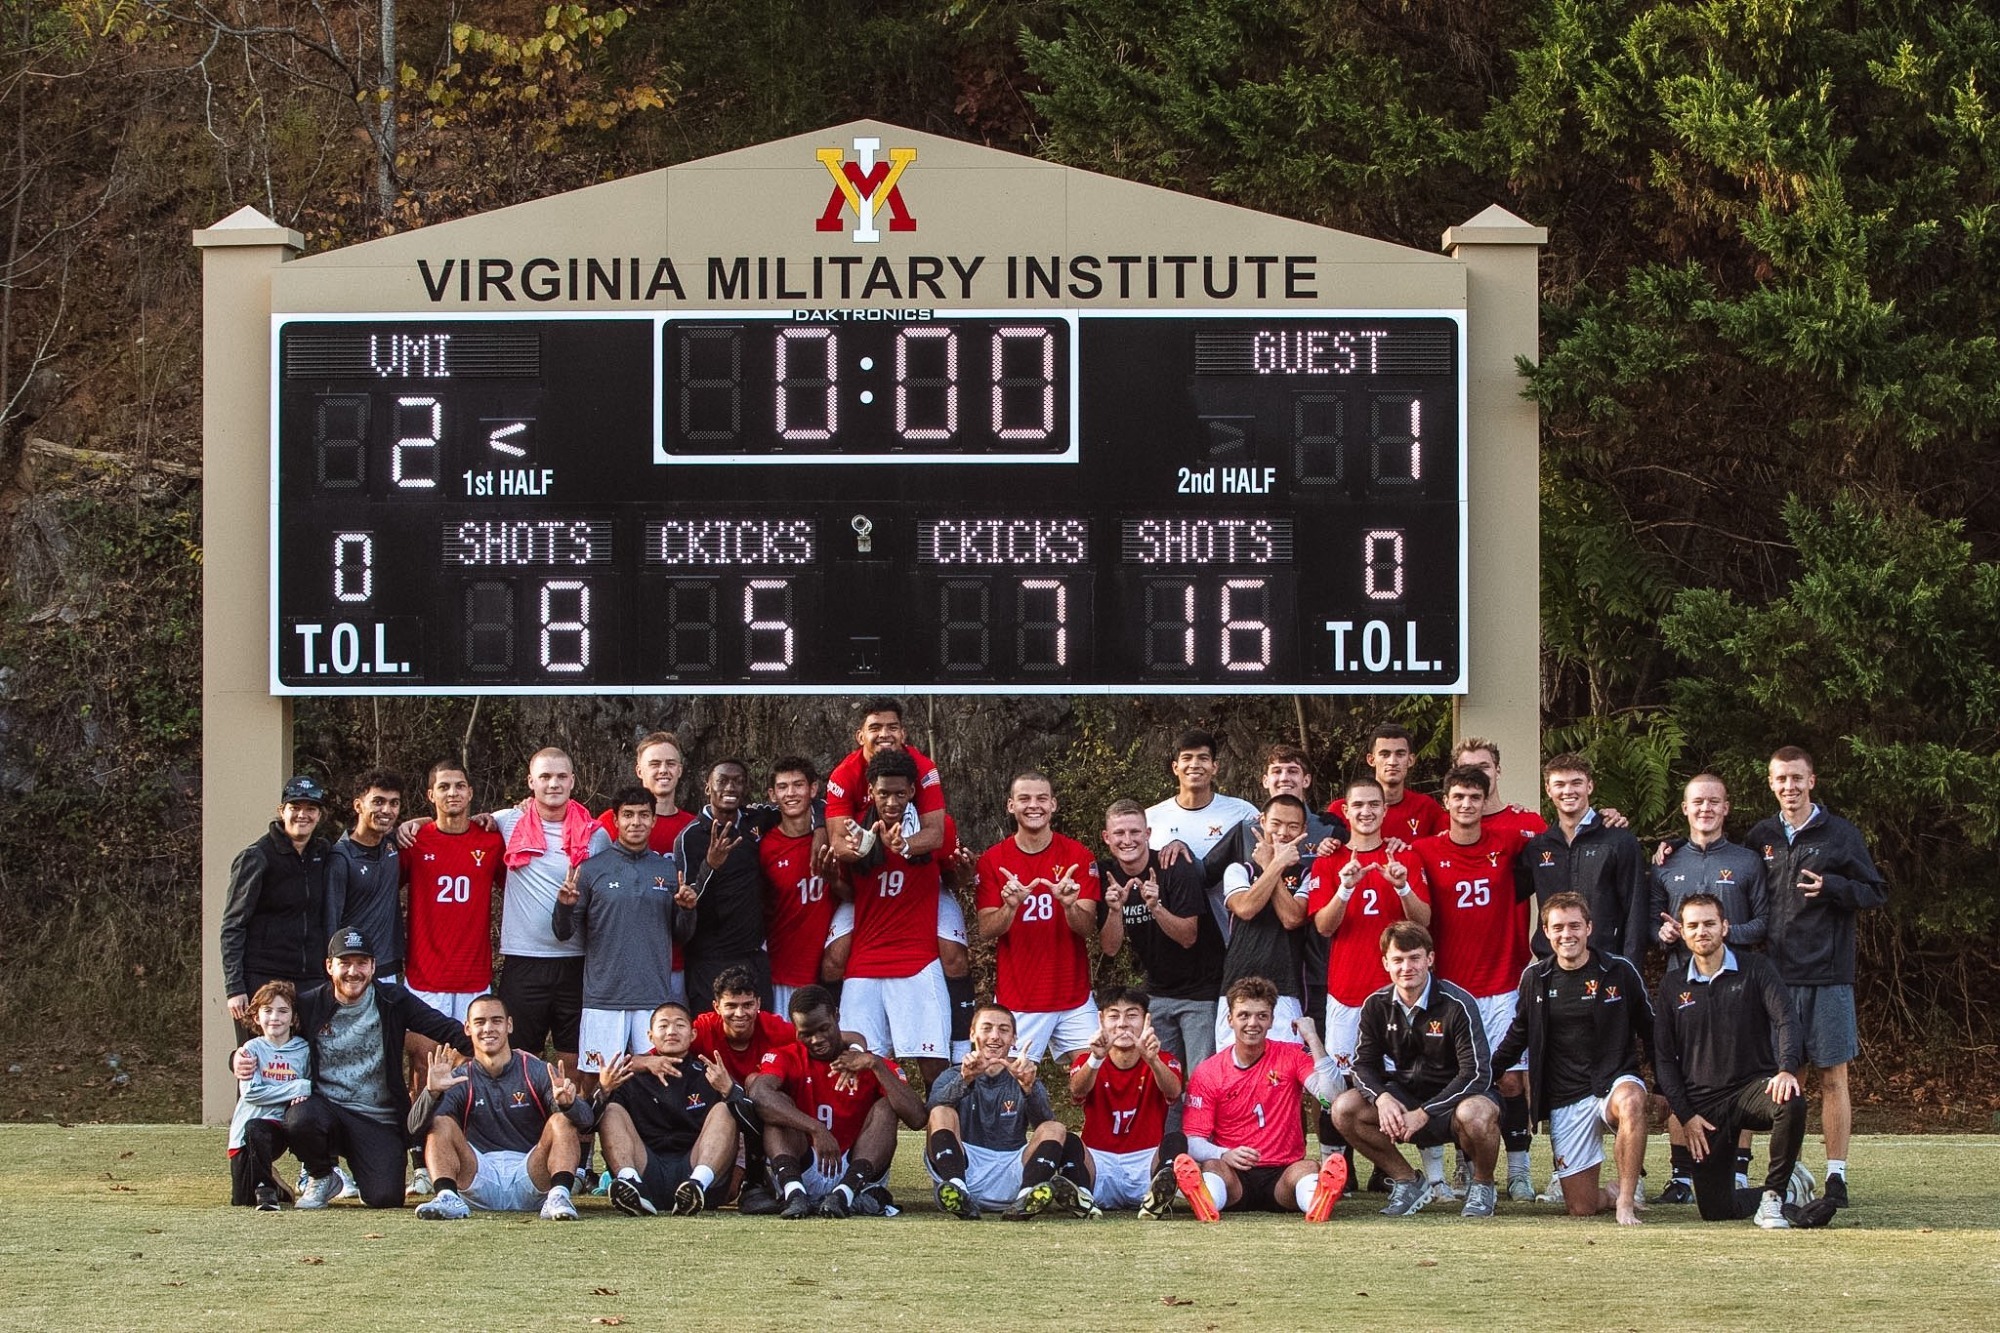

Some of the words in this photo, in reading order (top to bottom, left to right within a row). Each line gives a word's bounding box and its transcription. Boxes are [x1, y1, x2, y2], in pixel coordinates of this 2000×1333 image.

[418, 258, 685, 302] VIRGINIA
[708, 257, 984, 300] MILITARY
[1008, 256, 1317, 299] INSTITUTE
[795, 309, 931, 320] DAKTRONICS
[370, 334, 451, 378] VMI
[1253, 330, 1388, 374] GUEST
[775, 327, 1054, 441] 0:00
[391, 396, 443, 488] 2
[1409, 399, 1422, 480] 1
[463, 470, 494, 496] 1st
[500, 469, 554, 496] HALF
[1177, 467, 1215, 495] 2nd
[1222, 467, 1276, 495] HALF
[456, 521, 593, 565] SHOTS
[660, 520, 812, 564] CKICKS
[932, 519, 1085, 564] CKICKS
[1137, 519, 1273, 563] SHOTS
[334, 532, 373, 602] 0
[1364, 530, 1403, 600] 0
[540, 580, 590, 672] 8
[743, 579, 794, 672] 5
[1021, 579, 1066, 666] 7
[1184, 579, 1271, 672] 16
[296, 623, 410, 674] T.O.L.
[1325, 619, 1443, 672] T.O.L.
[436, 875, 470, 903] 20
[796, 875, 823, 905] 10
[877, 870, 904, 897] 19
[1362, 889, 1379, 915] 2
[1455, 878, 1491, 908] 25
[1022, 893, 1053, 921] 28
[268, 1062, 289, 1070] VMI
[817, 1104, 833, 1131] 9
[1112, 1108, 1137, 1135] 17
[1252, 1103, 1266, 1128] 1
